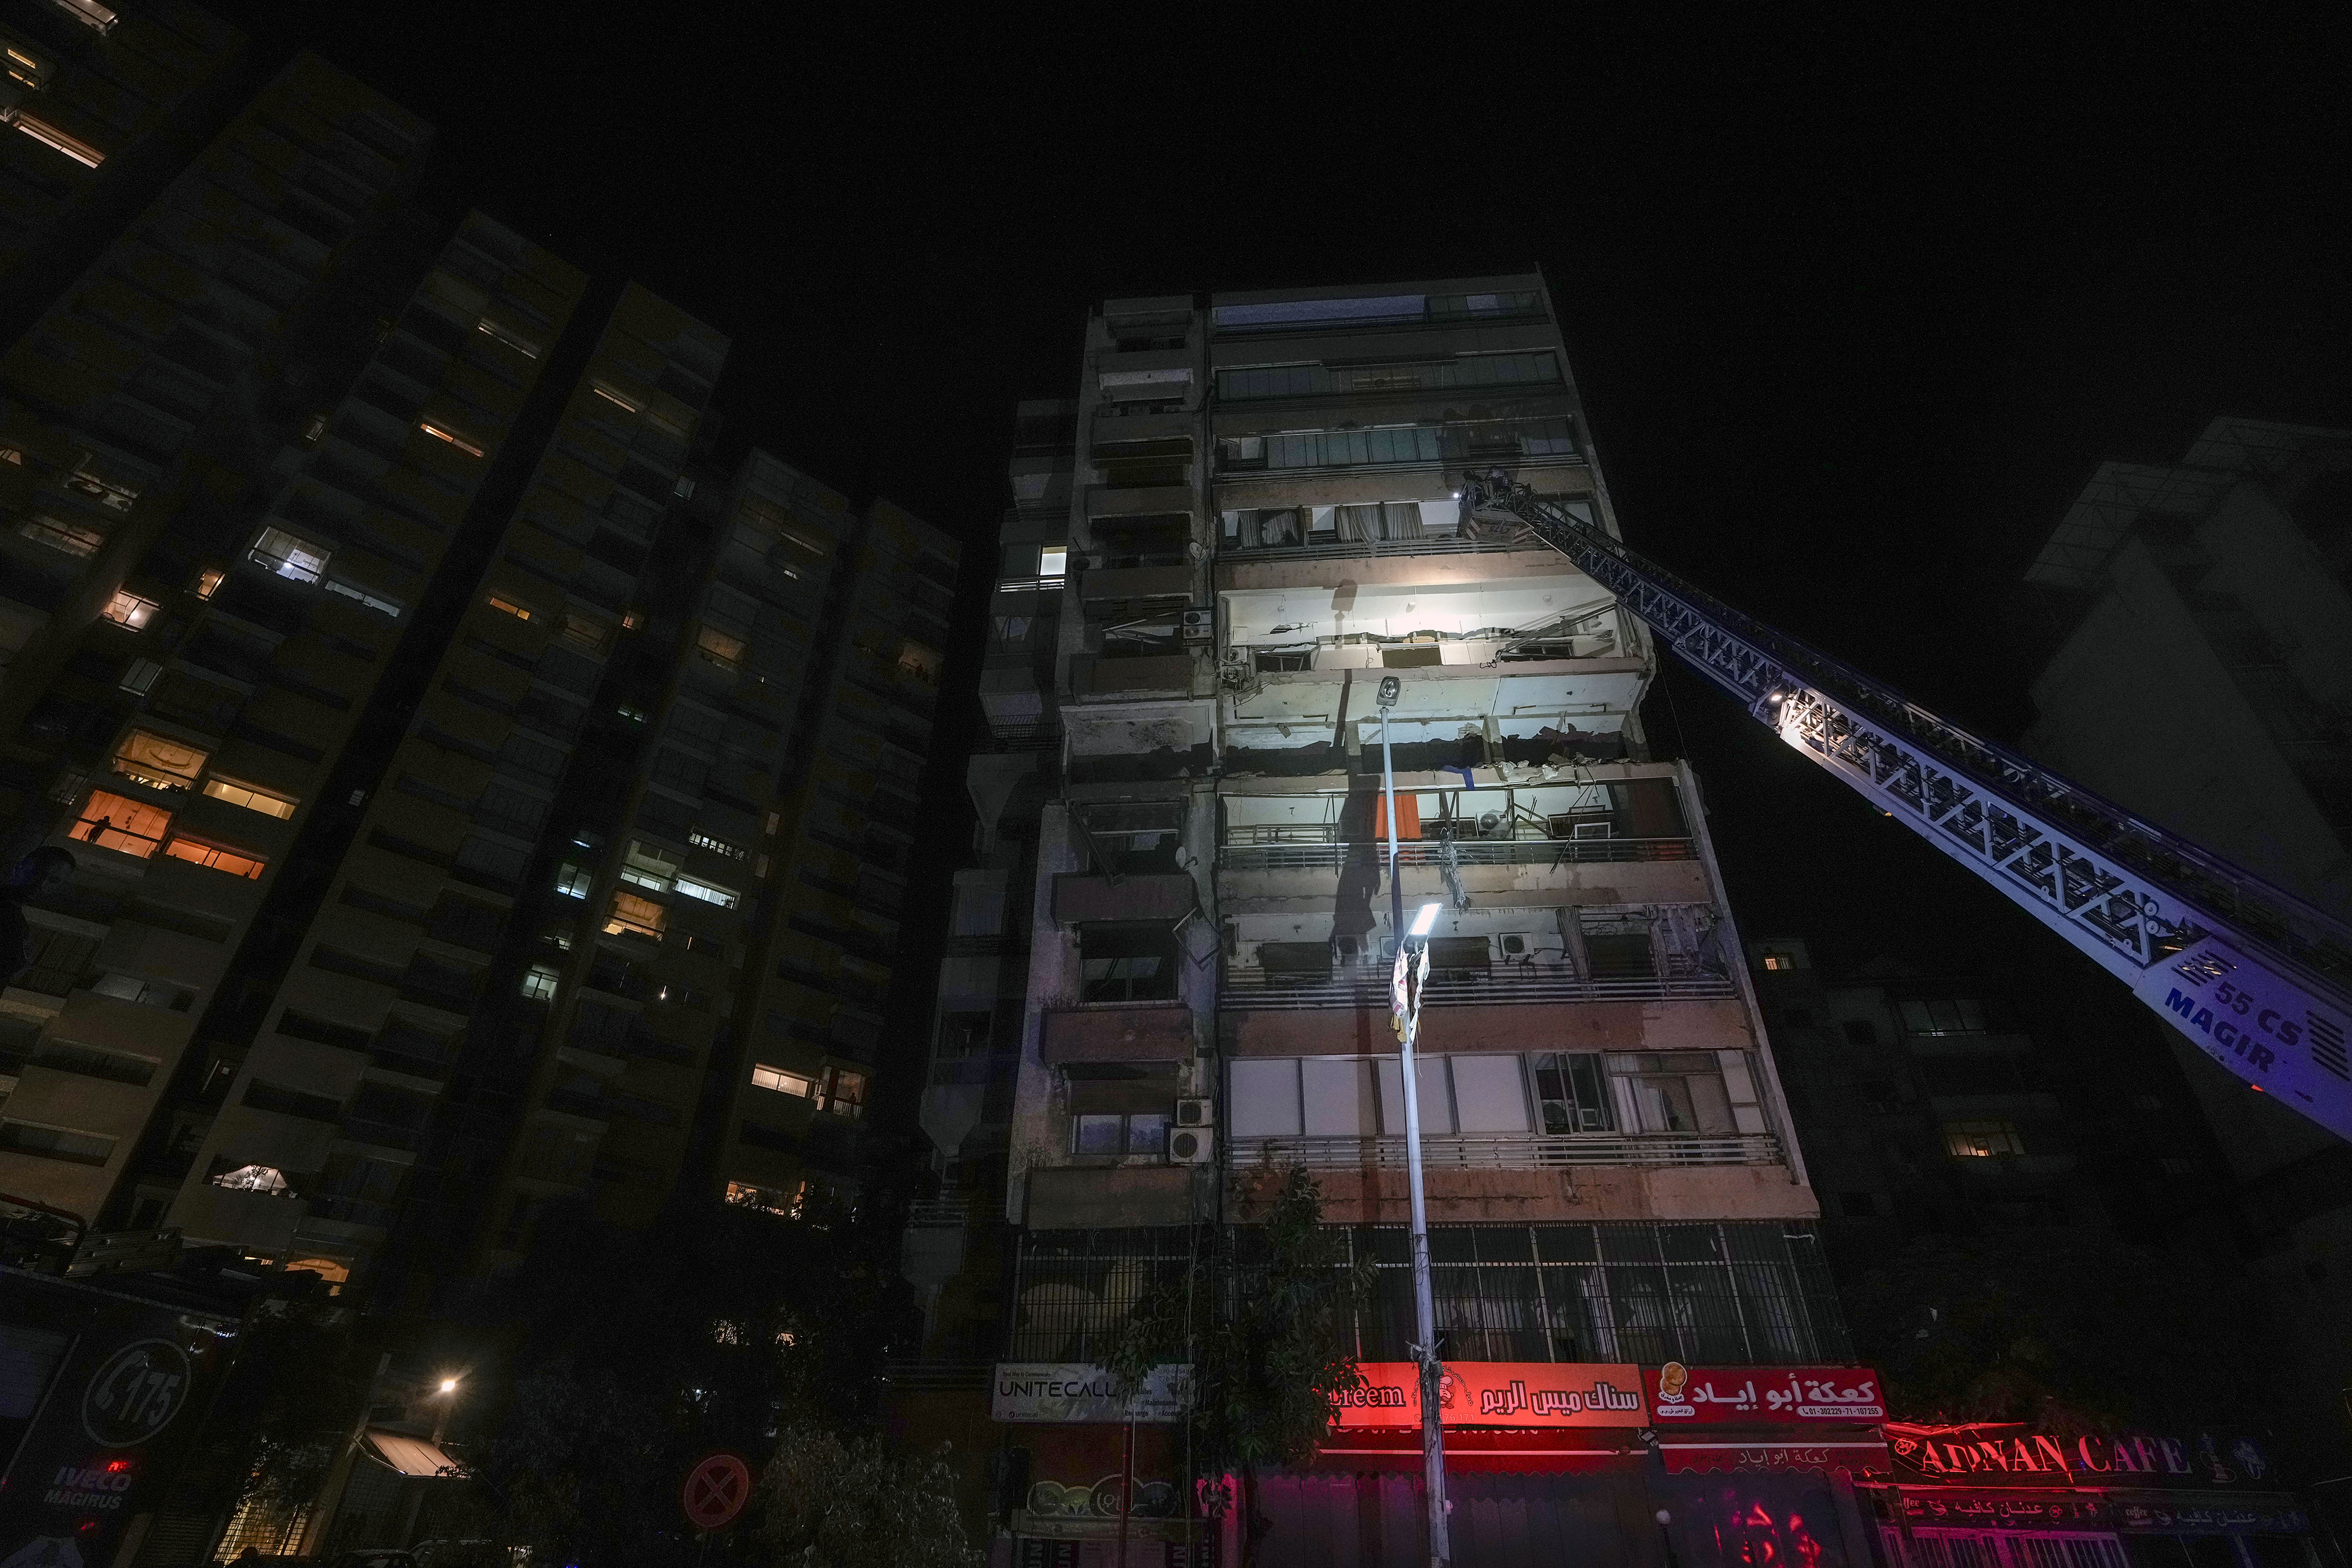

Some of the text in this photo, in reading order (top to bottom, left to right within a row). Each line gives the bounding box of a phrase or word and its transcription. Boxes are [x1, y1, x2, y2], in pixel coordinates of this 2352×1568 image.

[2164, 987, 2275, 1073] MAGIR
[2215, 981, 2303, 1046] 55 CS
[119, 1368, 181, 1427] 175
[1000, 1381, 1117, 1397] UNITECALL
[1482, 1381, 1639, 1415] سناك ميس الريم
[1692, 1372, 1876, 1411] كعكة أبو إياد
[1459, 1413, 1474, 1422] 171
[1793, 1448, 1830, 1463] كعكة
[1920, 1435, 2193, 1474] ADNAN CAFE
[53, 1464, 133, 1492] IVECO
[43, 1489, 123, 1509] MAGIRUS
